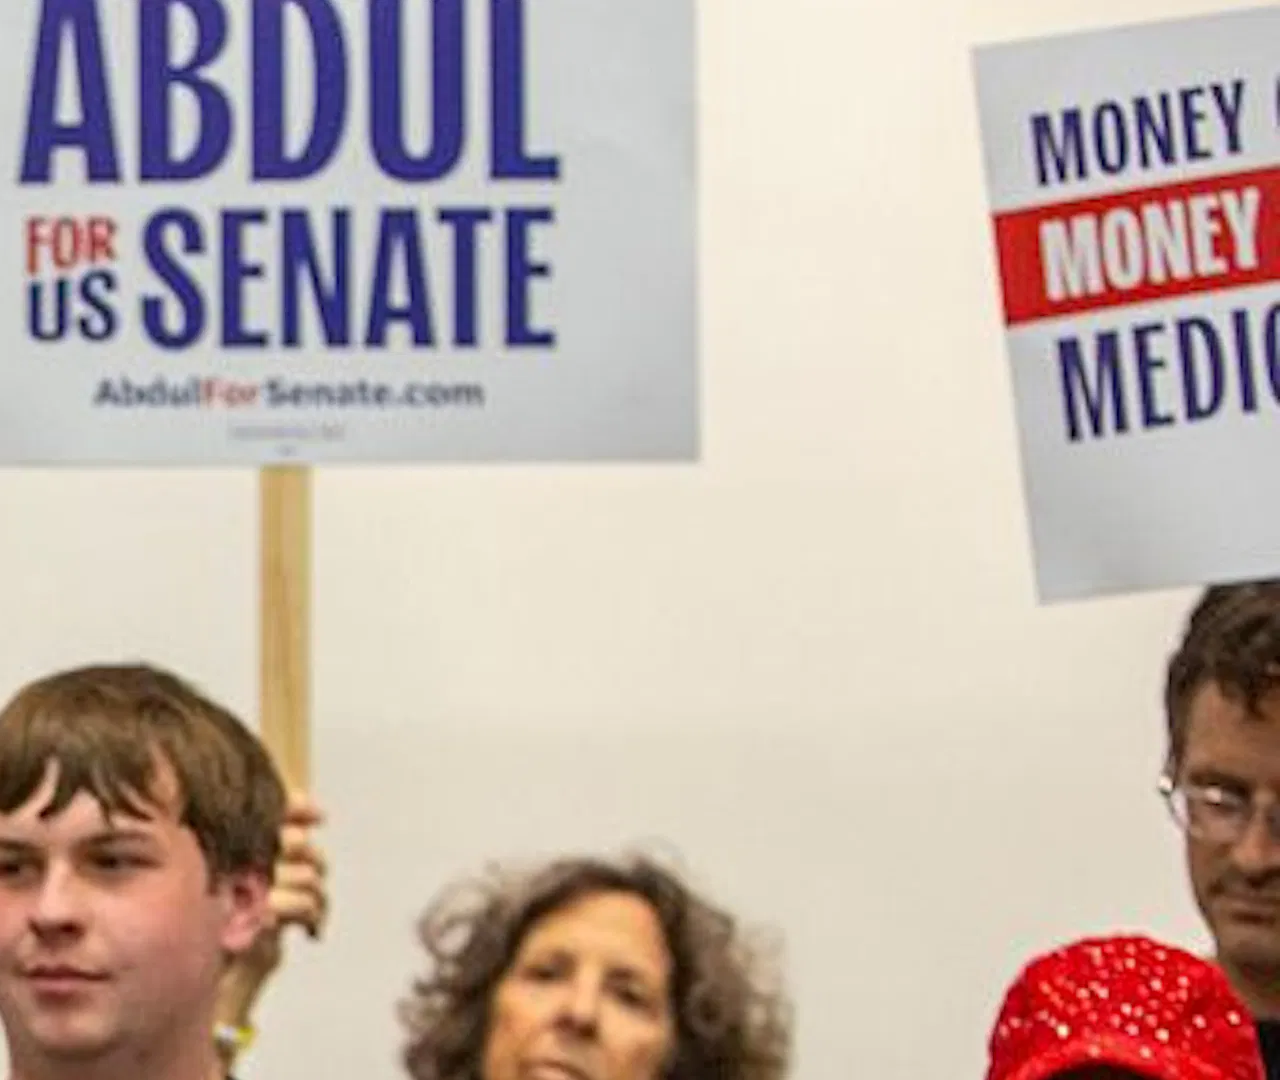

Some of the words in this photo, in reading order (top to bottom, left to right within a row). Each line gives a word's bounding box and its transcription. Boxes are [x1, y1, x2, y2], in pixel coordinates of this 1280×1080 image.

[18, 0, 561, 185] ABDUL
[1030, 79, 1245, 187] MONEY
[25, 216, 117, 275] FOR
[27, 269, 119, 342] US
[142, 207, 557, 351] SENATE
[1041, 188, 1261, 302] MONEY
